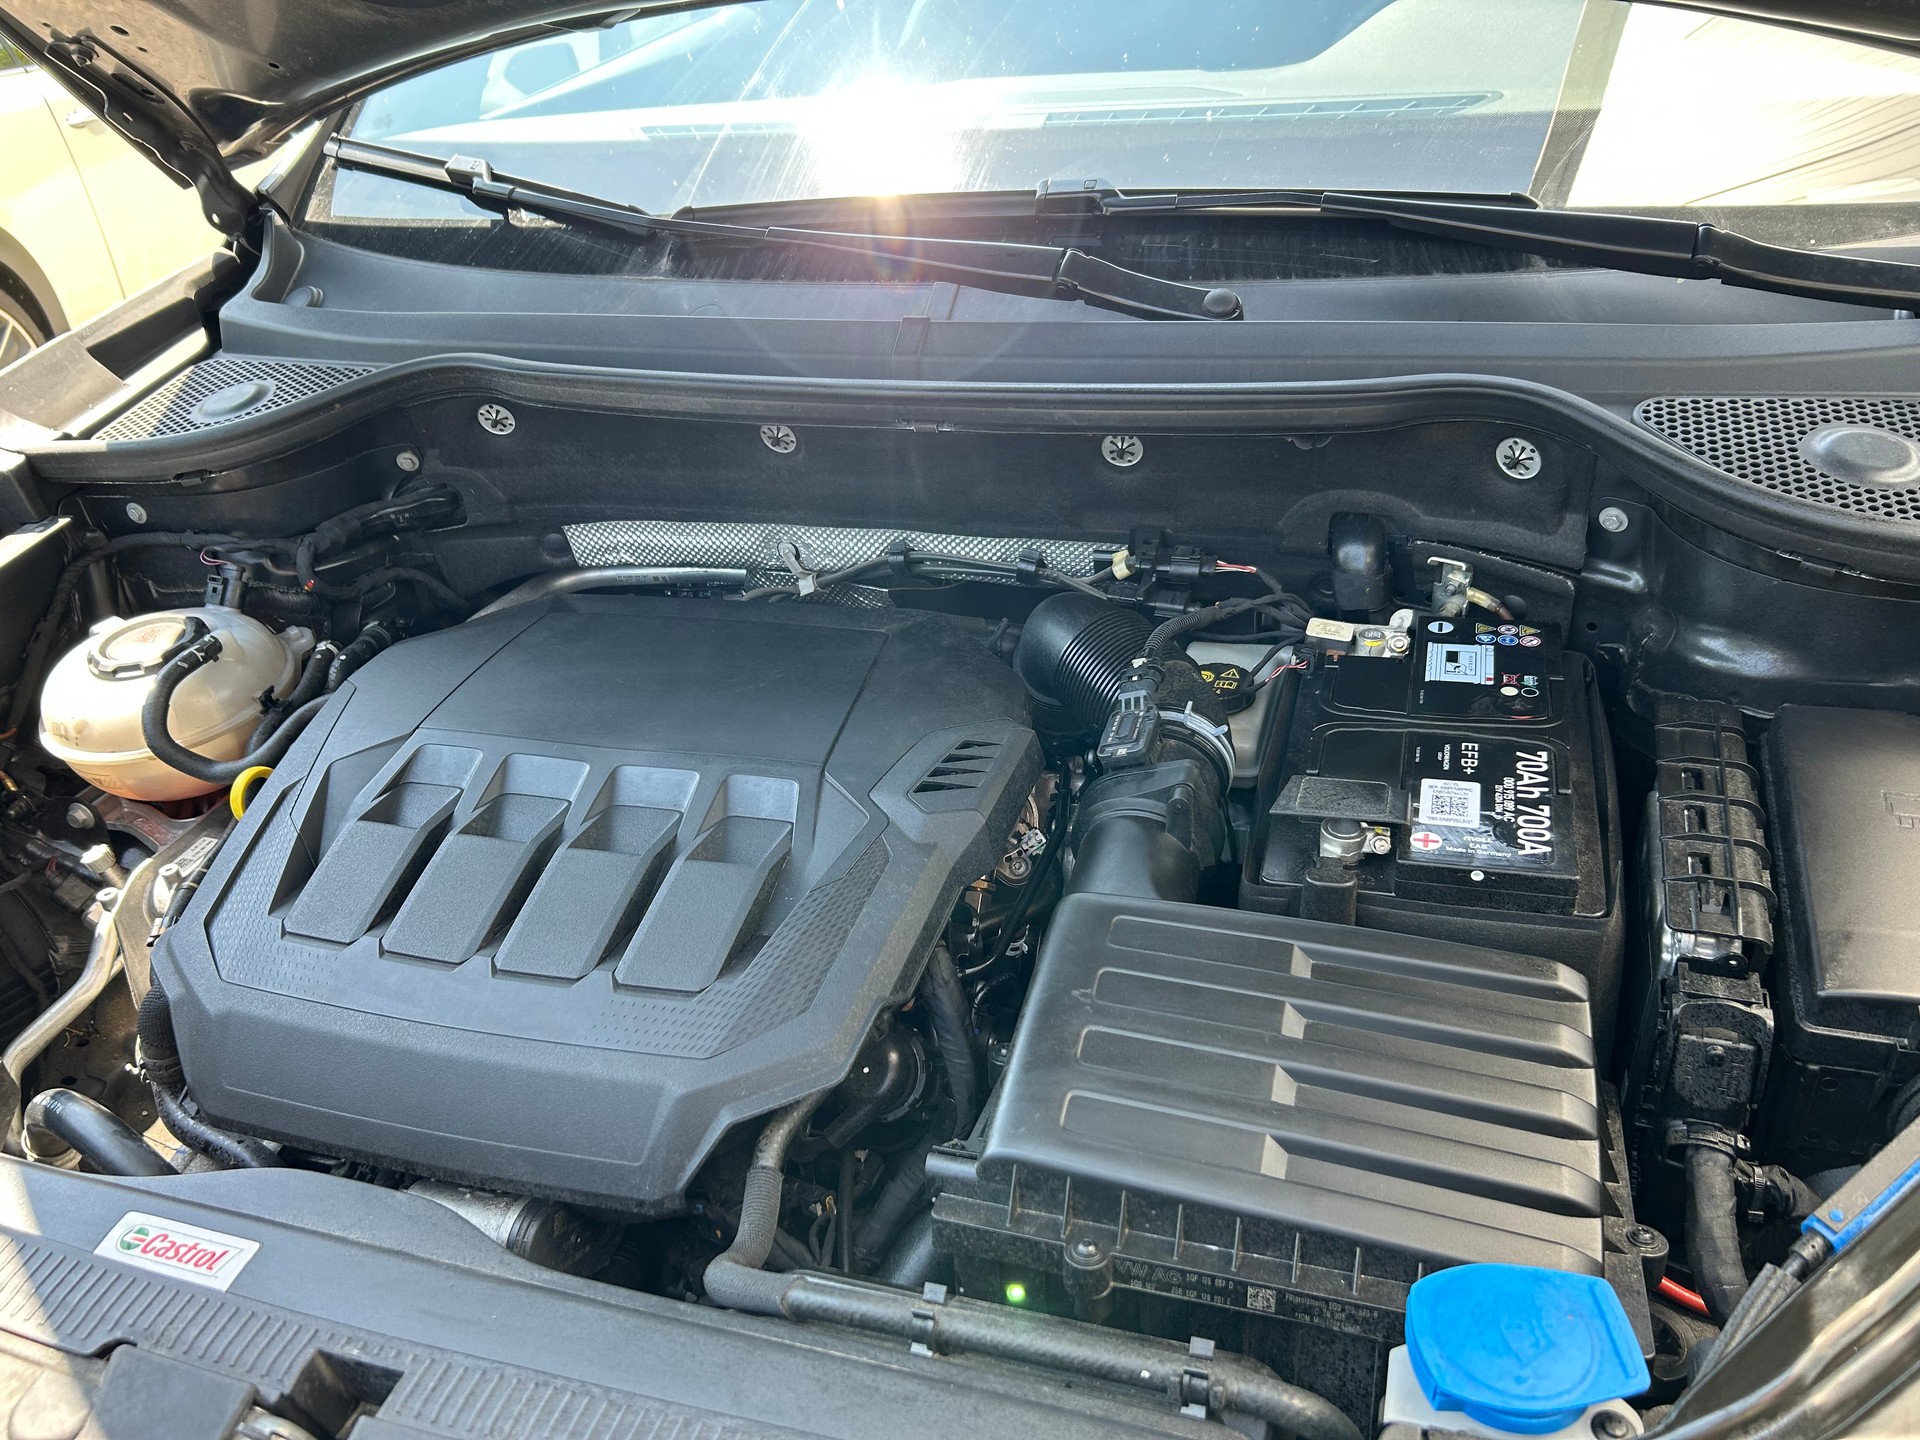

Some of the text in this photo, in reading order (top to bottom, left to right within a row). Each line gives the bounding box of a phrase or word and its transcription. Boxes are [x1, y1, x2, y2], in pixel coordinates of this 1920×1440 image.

[1460, 742, 1479, 775] EFB+
[1503, 811, 1516, 823] AC
[1516, 751, 1553, 856] 70Ah 700A
[1476, 849, 1512, 858] Germany
[140, 1233, 231, 1271] Castrol
[1114, 1259, 1148, 1278] VW
[1151, 1267, 1182, 1284] AG
